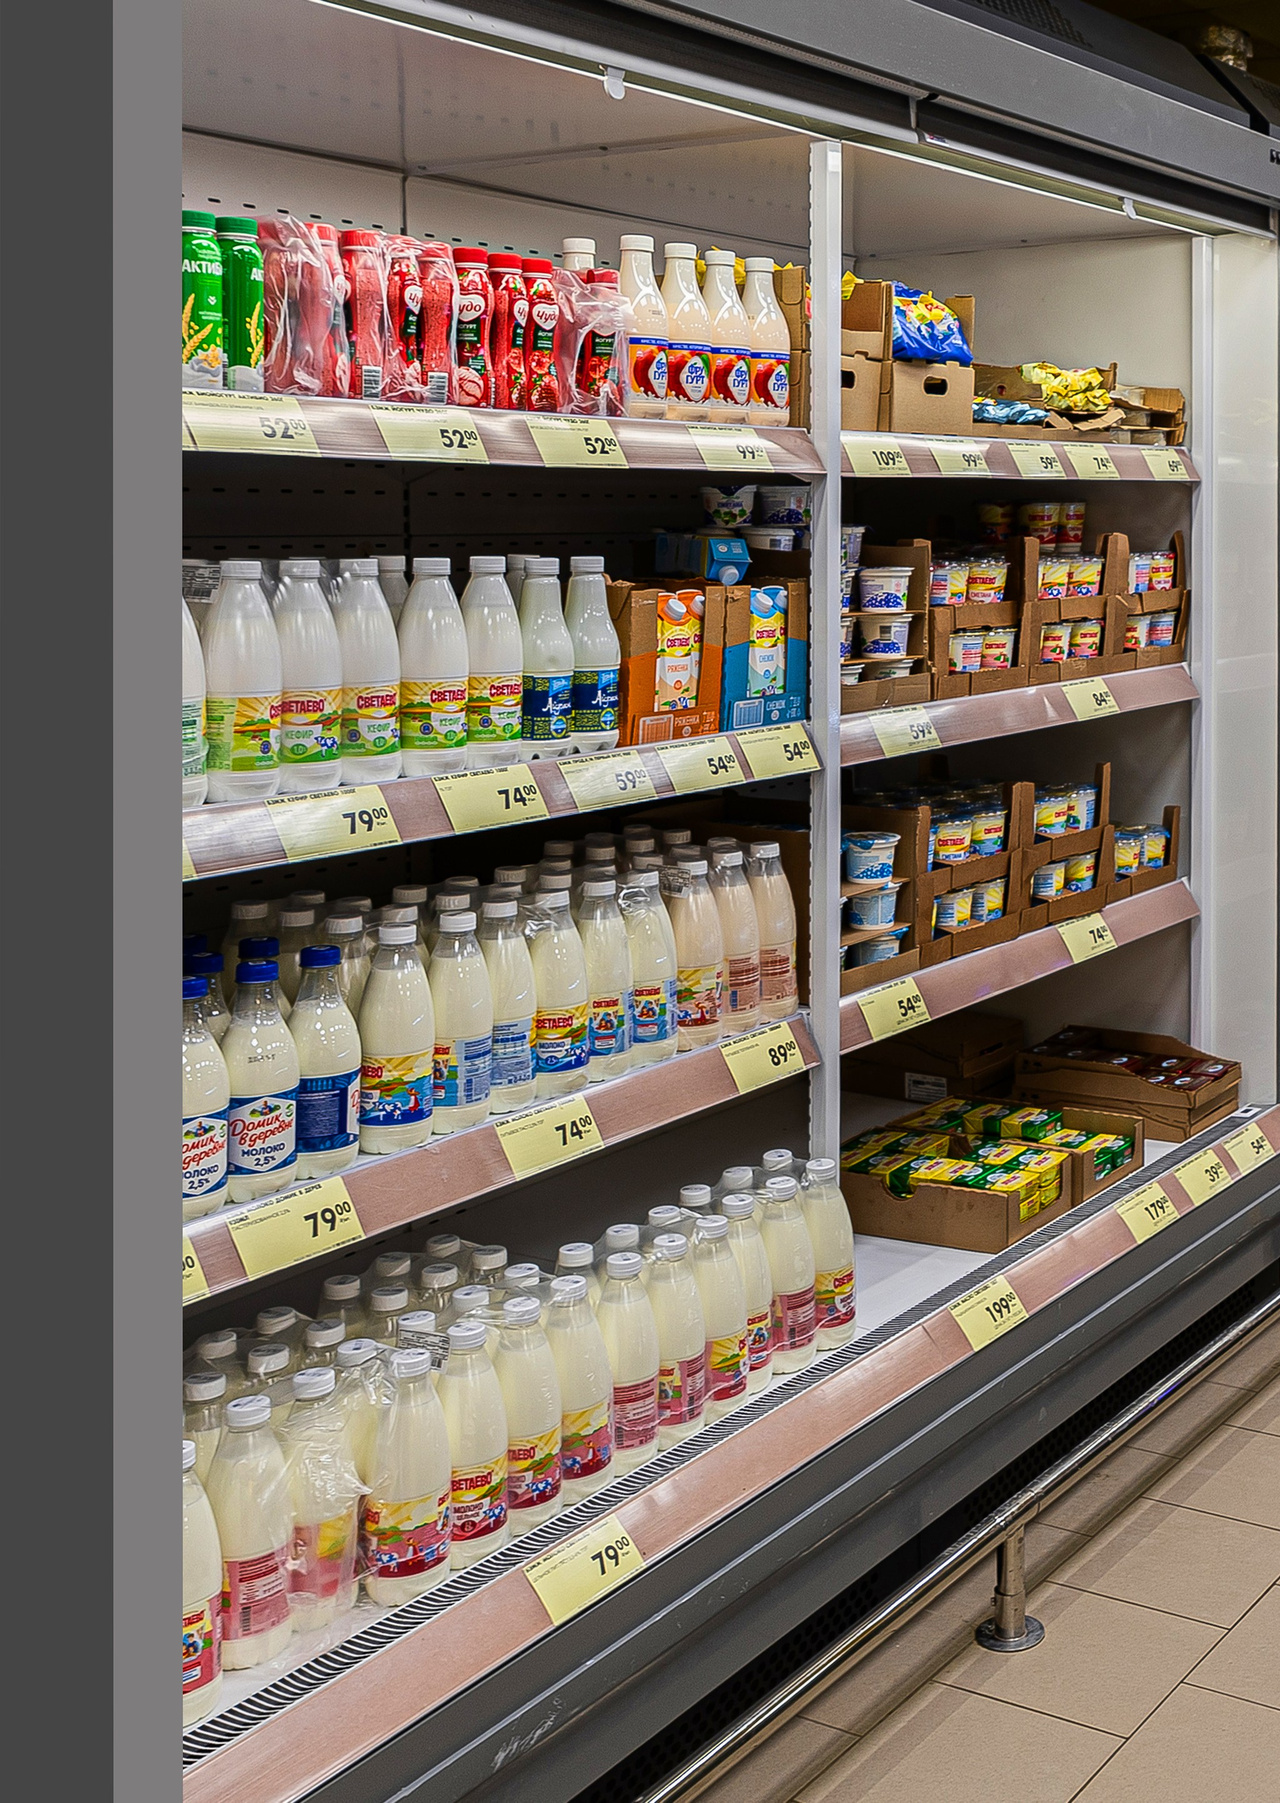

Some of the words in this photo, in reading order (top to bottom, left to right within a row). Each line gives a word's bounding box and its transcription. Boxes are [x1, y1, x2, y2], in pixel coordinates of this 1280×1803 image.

[281, 699, 325, 714] ВЕТАЕВО
[183, 1133, 217, 1154] омик
[241, 1142, 286, 1158] МОЛОКО
[183, 1164, 219, 1180] ОЛОКО
[452, 1471, 494, 1491] ВЕТАЕВО
